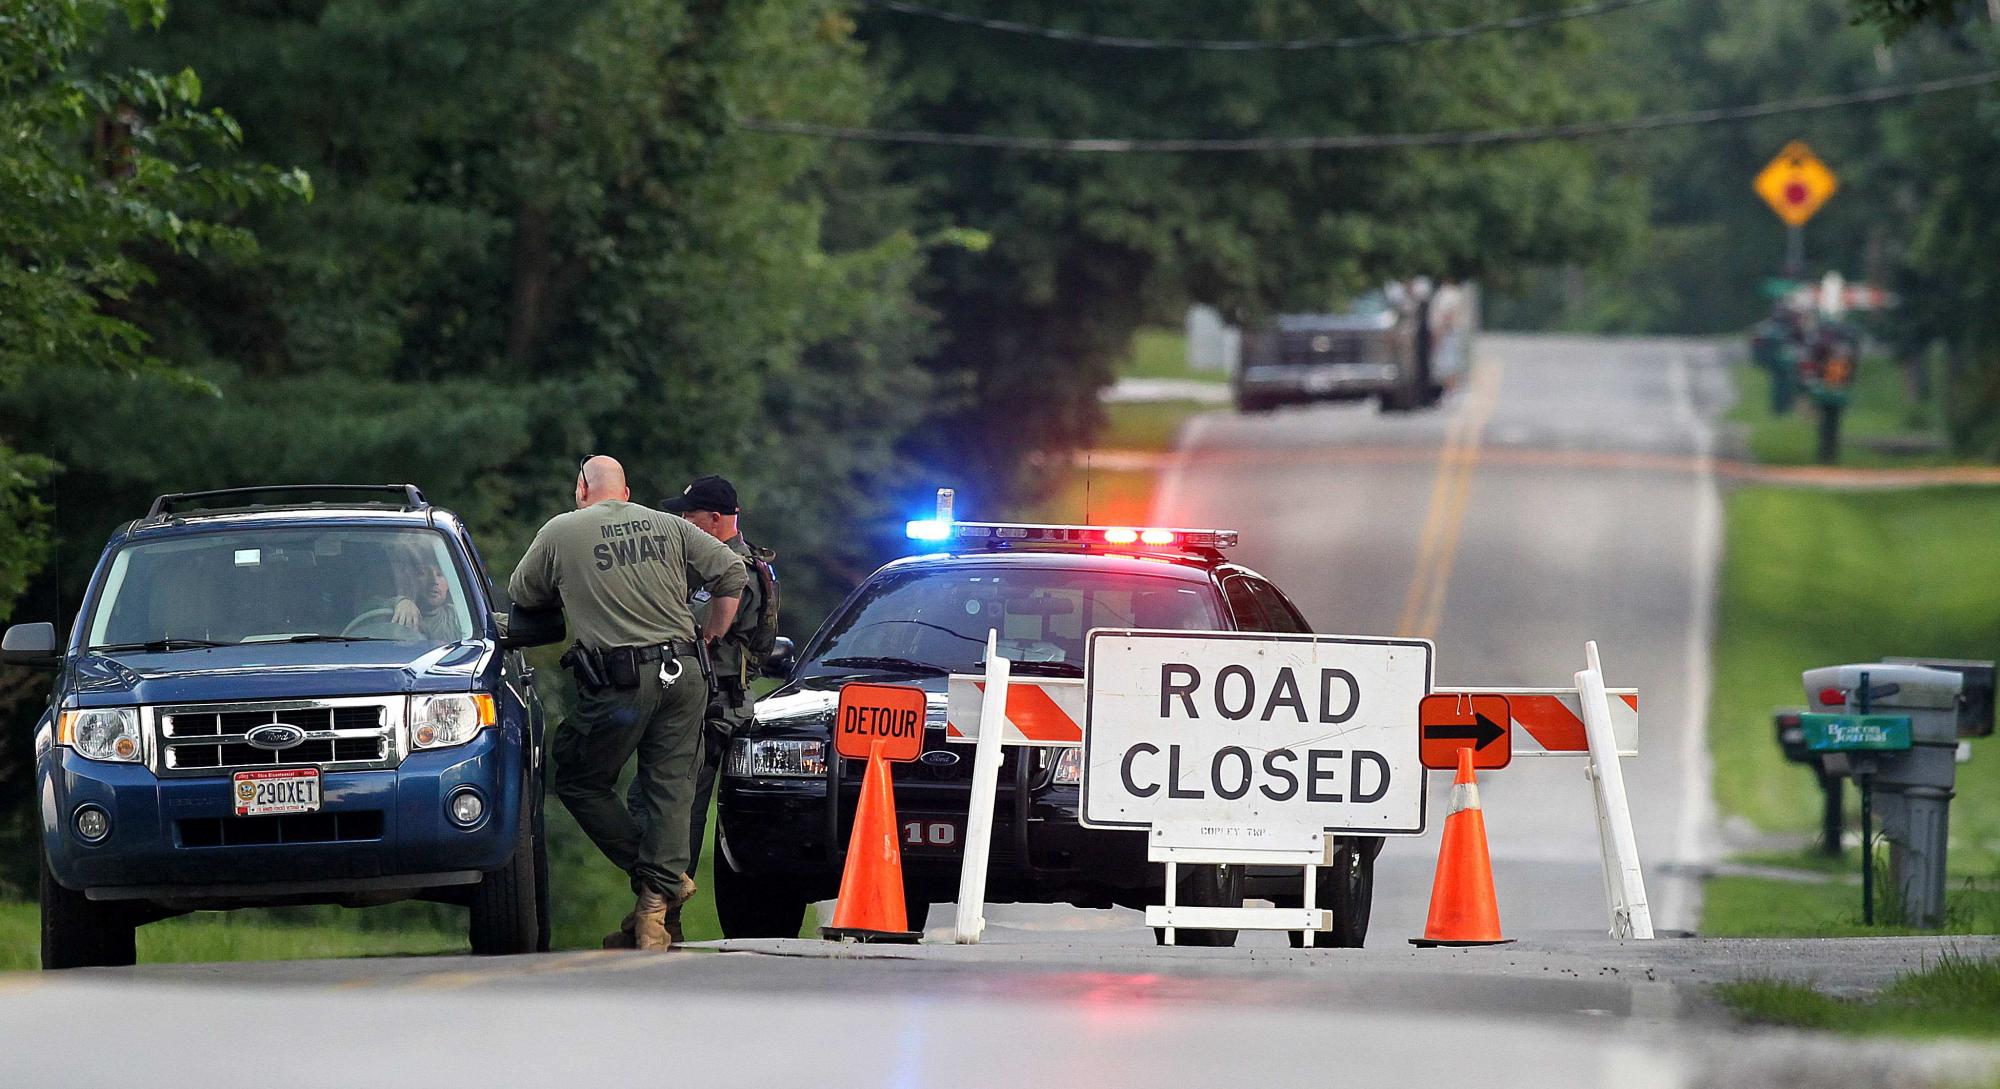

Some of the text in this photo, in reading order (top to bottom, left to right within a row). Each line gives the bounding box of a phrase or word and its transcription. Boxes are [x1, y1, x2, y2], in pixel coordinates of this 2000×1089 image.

[600, 520, 651, 538] METRO
[594, 535, 668, 571] SWAT
[1160, 663, 1360, 724] ROAD
[845, 705, 917, 738] DETOUR
[1120, 742, 1391, 803] CLOSED
[257, 780, 315, 805] 290XET
[905, 822, 955, 843] 10
